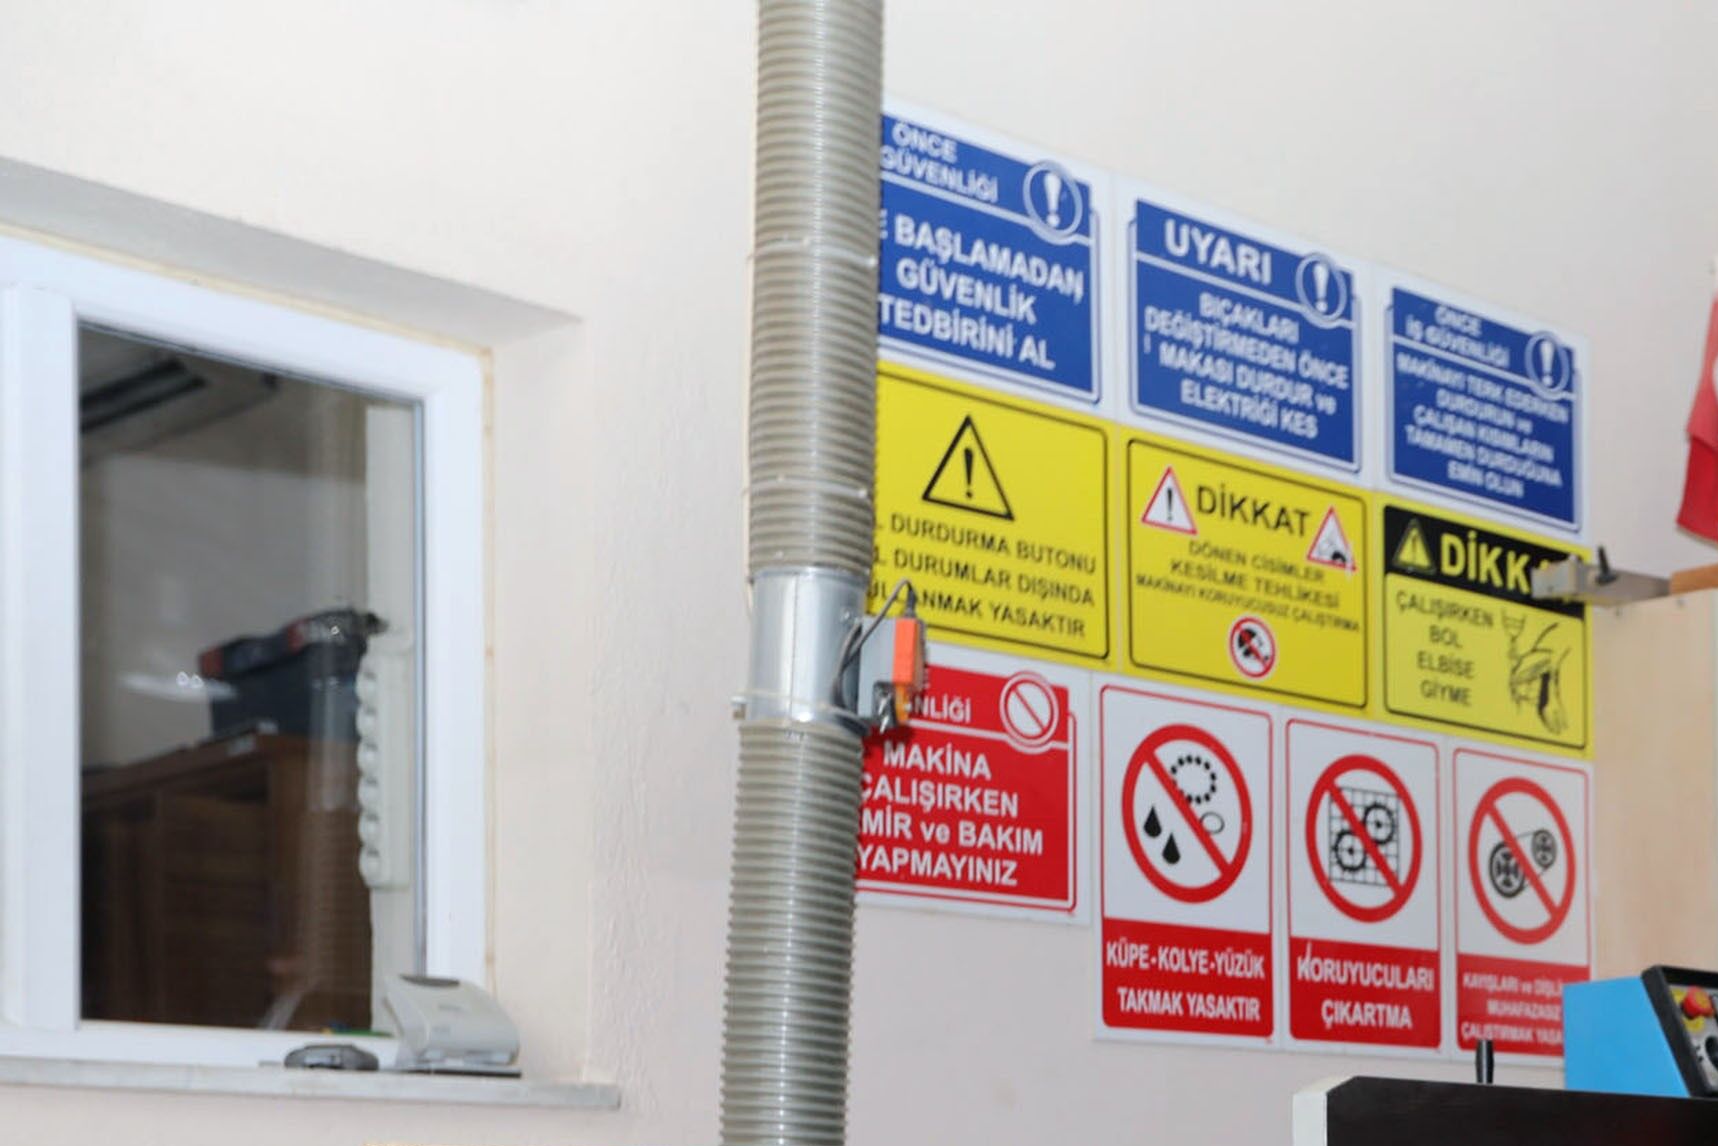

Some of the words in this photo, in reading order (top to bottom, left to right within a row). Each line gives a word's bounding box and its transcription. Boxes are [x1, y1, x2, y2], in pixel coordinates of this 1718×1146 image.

[894, 214, 1084, 304] BAŞLAMADAN
[1164, 218, 1272, 285] UYARI
[896, 256, 1038, 325] GÜVENLİK
[879, 294, 1014, 358] TEDBİRİNİ
[1018, 334, 1056, 370] AL
[1196, 482, 1311, 538] DİKKAT
[891, 513, 1008, 555] DURDURMA
[1016, 540, 1096, 575] BUTONU
[1440, 530, 1541, 594] DİKK
[894, 549, 1012, 592] DURUMLAR
[1018, 574, 1095, 607] DIŞINDA
[989, 602, 1086, 638] YASAKTIR
[1429, 624, 1463, 649] BOL
[883, 739, 992, 781] MAKİNA
[920, 821, 950, 843] ve
[959, 820, 1043, 855] BAKIM
[857, 843, 1018, 886] YAPMAYINIZ
[1297, 949, 1435, 991] KORUYUCULARI
[1117, 987, 1184, 1017] TAKMAK
[1186, 993, 1260, 1022] YASAKTIR
[1321, 998, 1413, 1030] ÇIKARTMA
